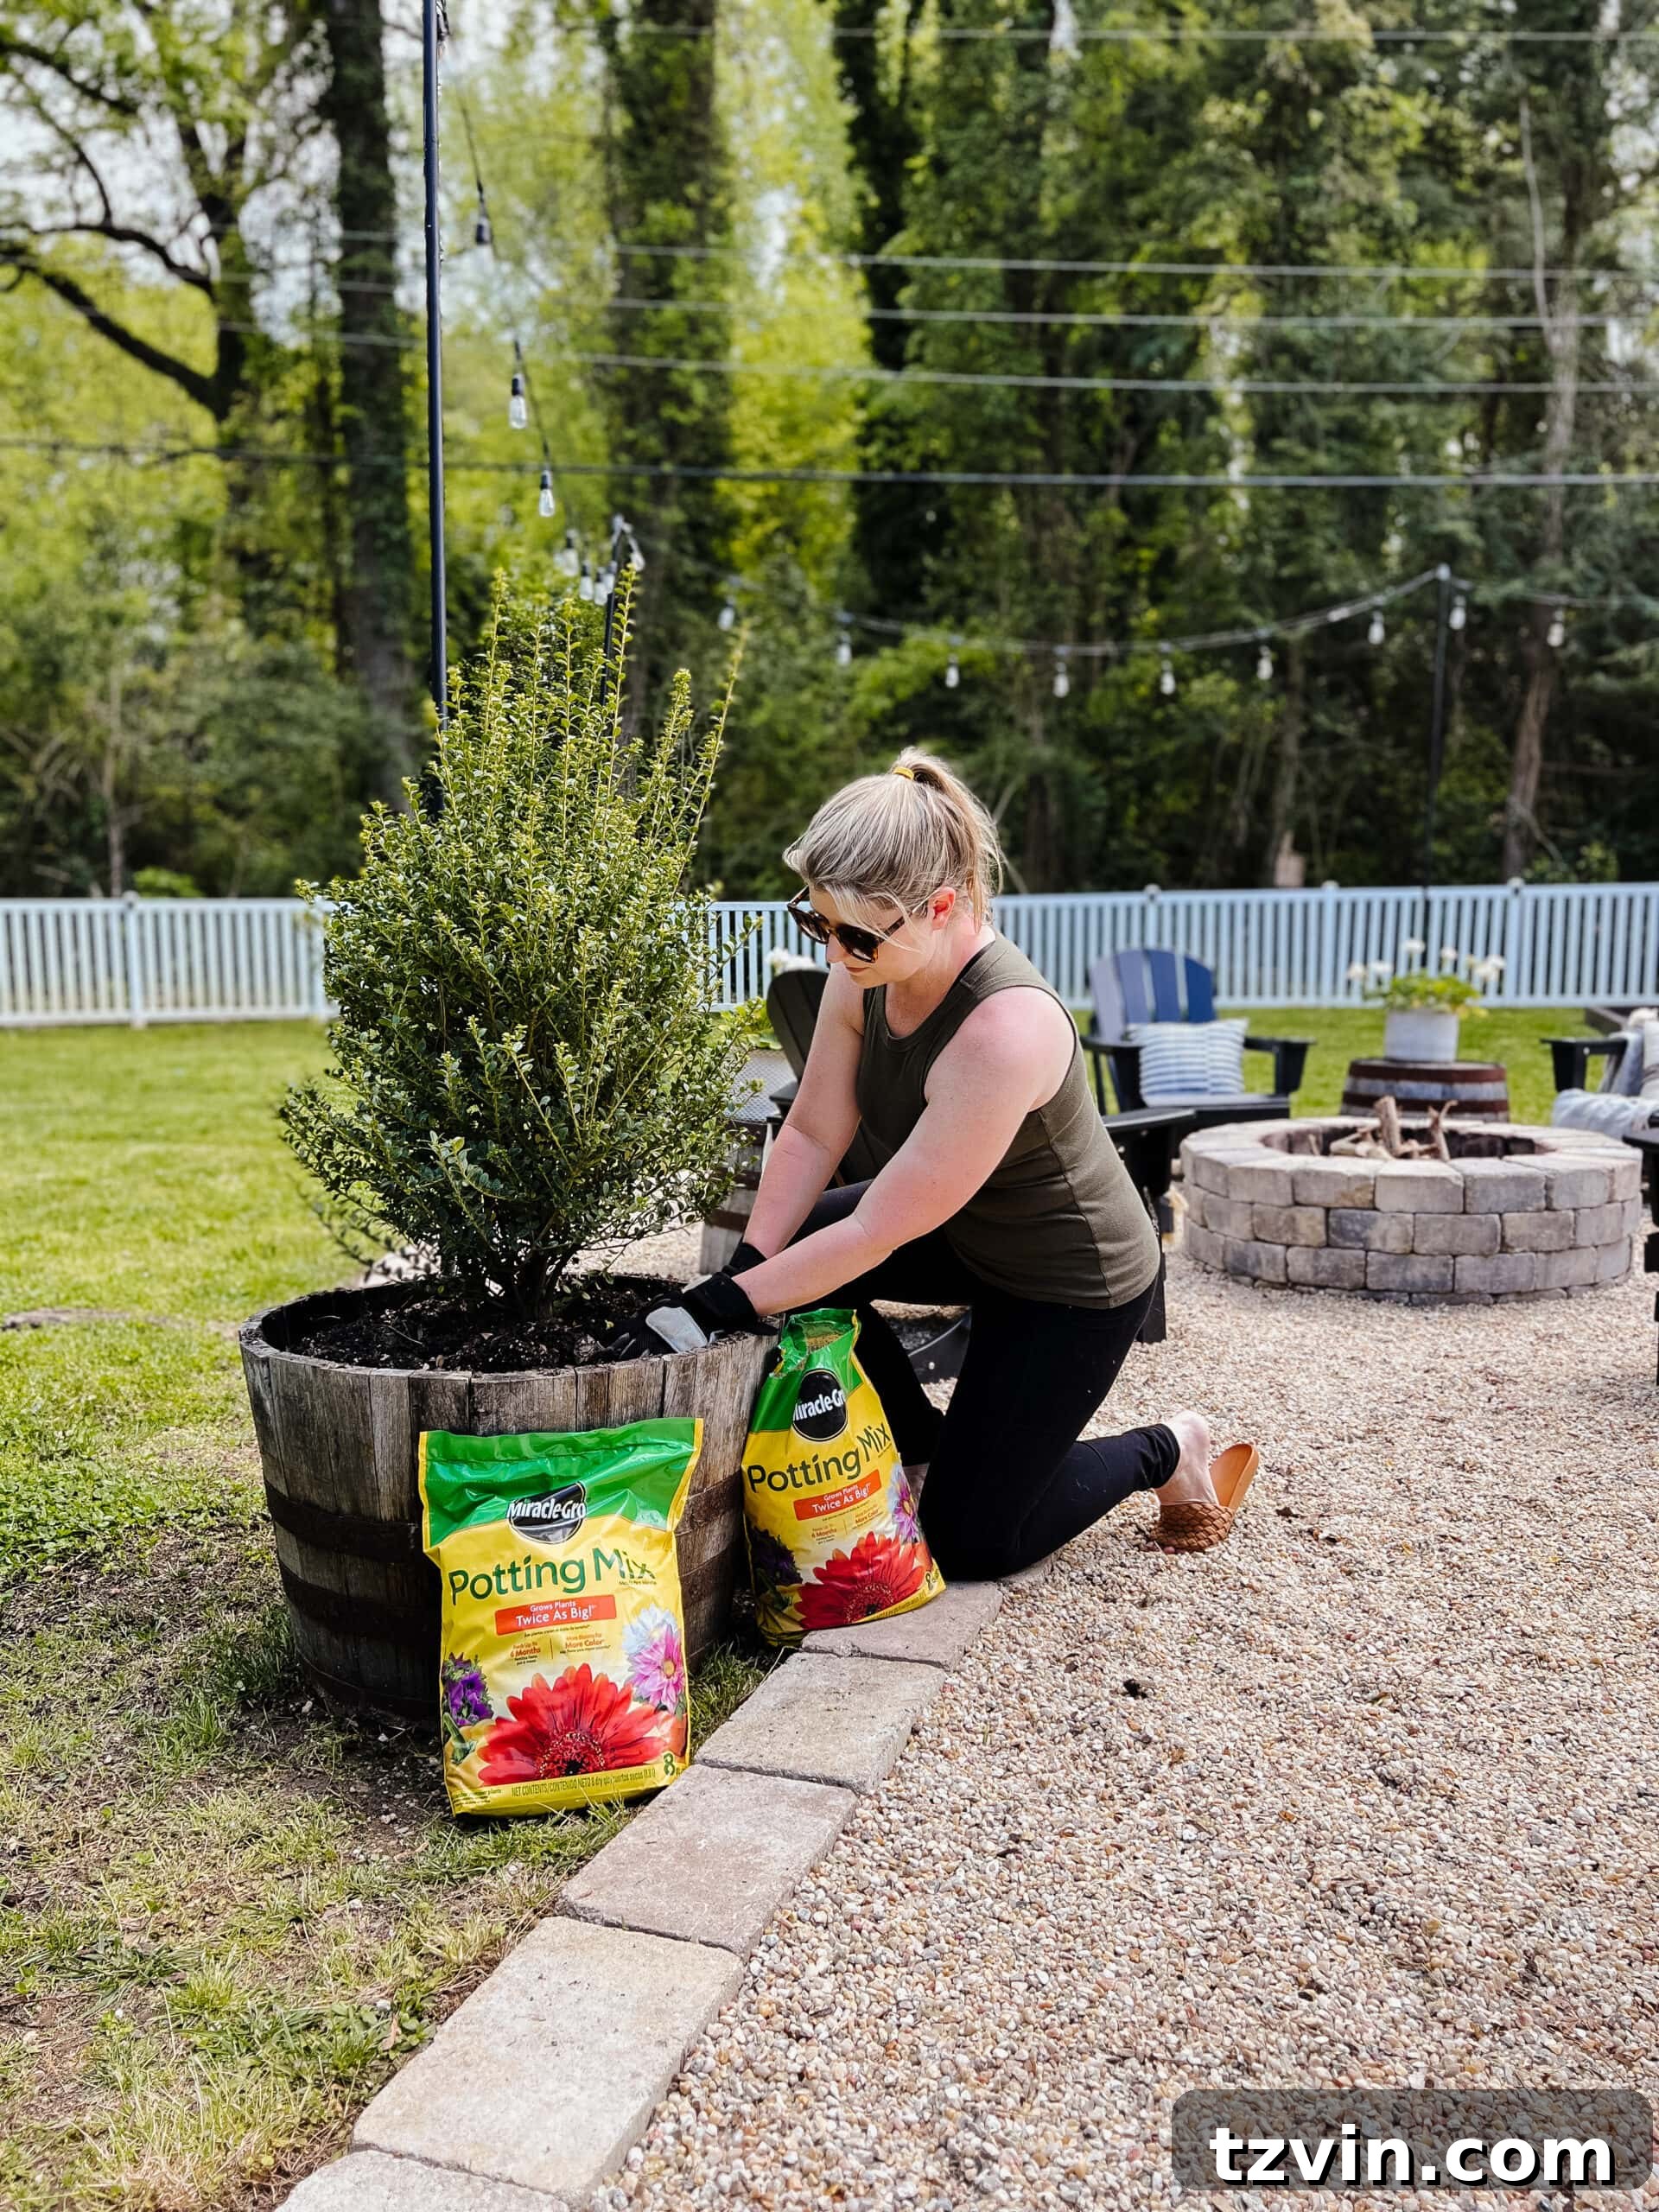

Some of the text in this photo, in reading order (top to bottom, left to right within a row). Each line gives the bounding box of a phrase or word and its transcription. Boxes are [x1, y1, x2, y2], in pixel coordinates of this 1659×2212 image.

[747, 1422, 891, 1493] Potting Mix
[506, 1498, 587, 1519] Miracle-Gro
[812, 1499, 841, 1514] Twice
[843, 1495, 854, 1504] As
[448, 1548, 655, 1605] Potting Mix
[516, 1612, 549, 1626] Twice
[553, 1611, 567, 1620] As
[516, 1647, 541, 1656] Months
[664, 1752, 675, 1776] 8
[512, 1786, 521, 1797] NET
